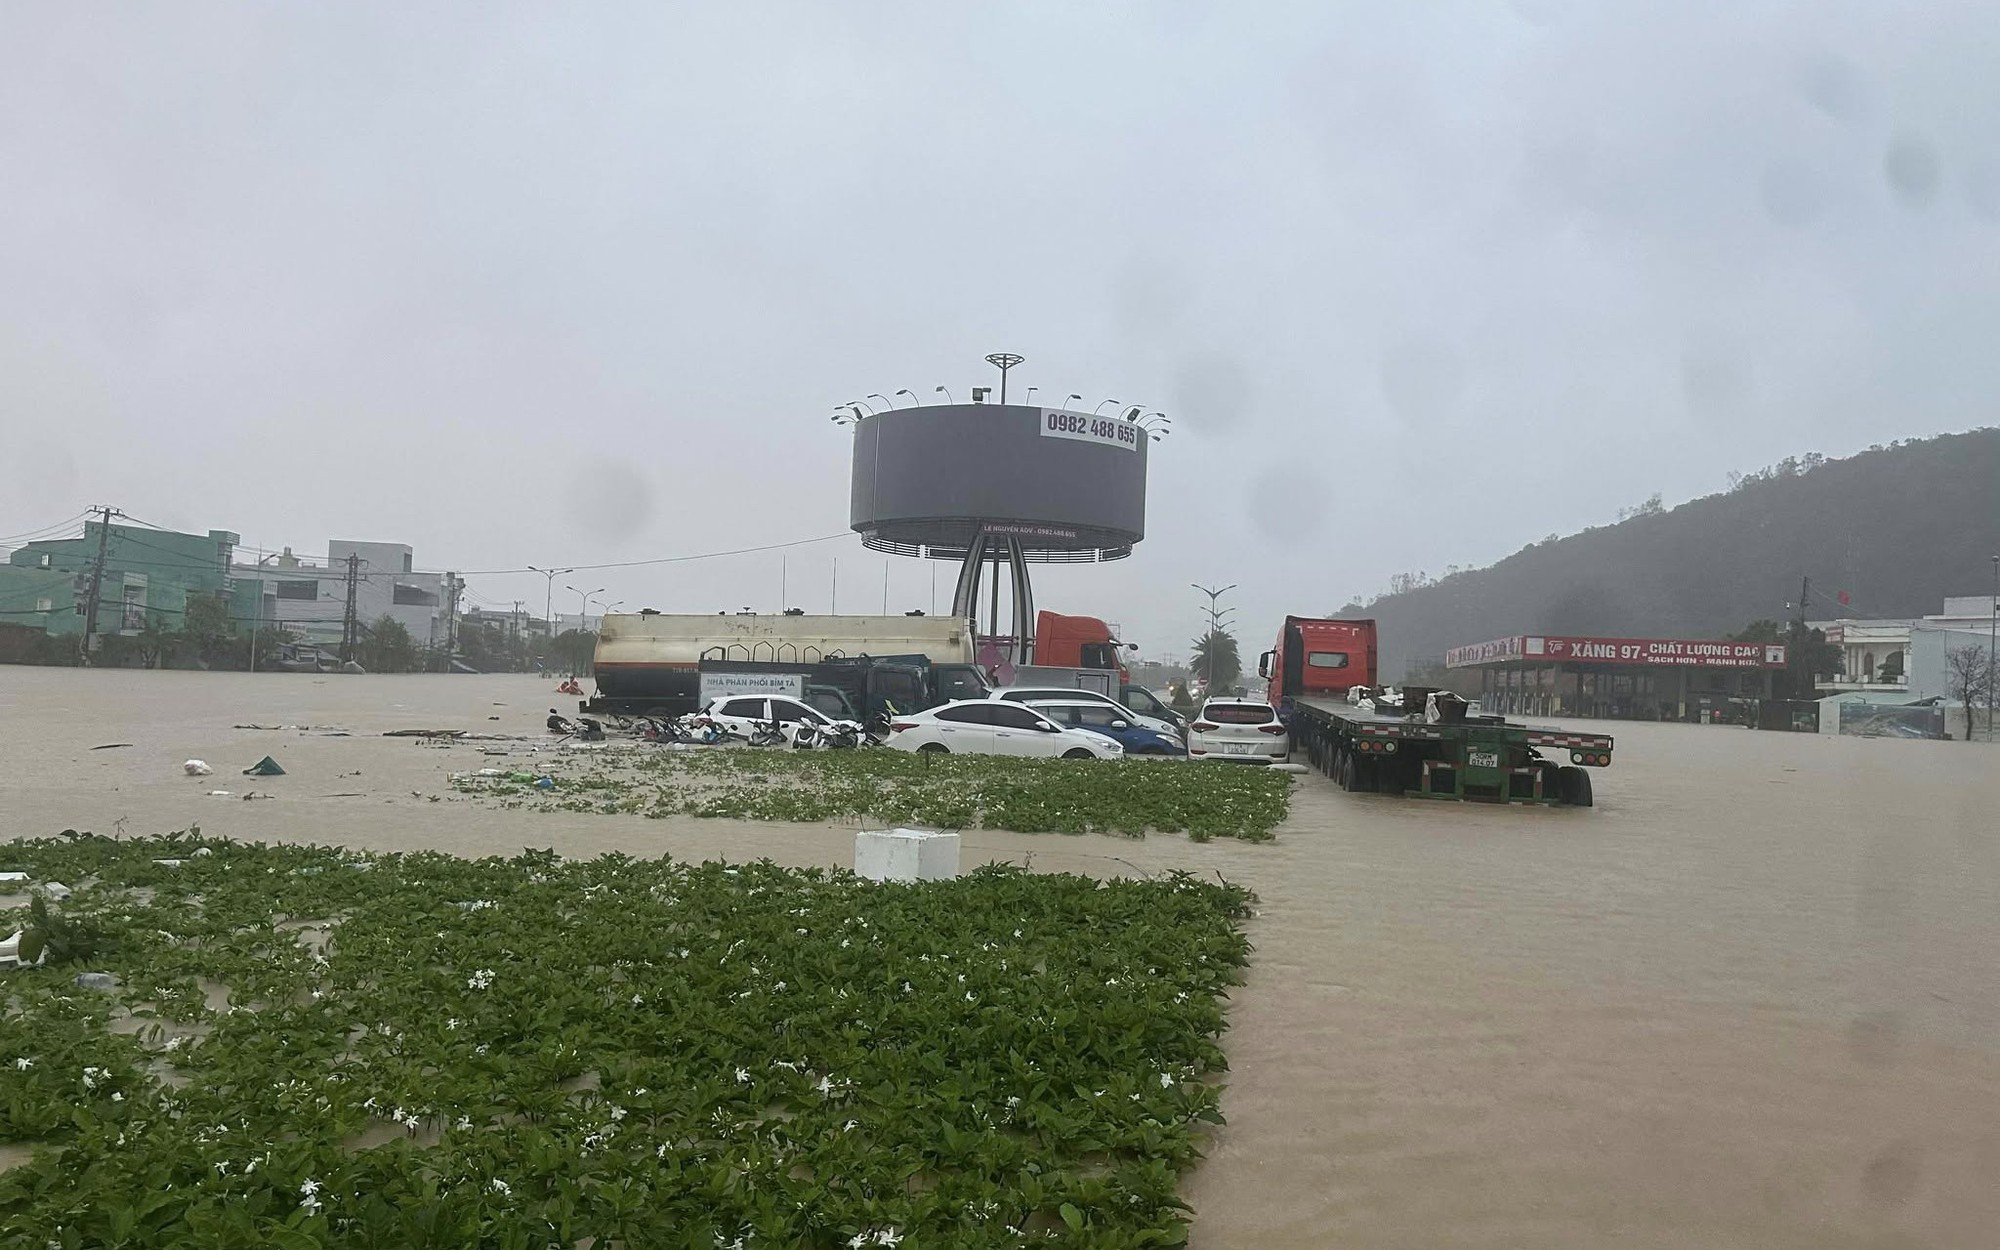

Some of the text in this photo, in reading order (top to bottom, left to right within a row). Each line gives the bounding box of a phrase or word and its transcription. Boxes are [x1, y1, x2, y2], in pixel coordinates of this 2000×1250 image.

[1047, 413, 1135, 444] 0982 488 655
[1570, 640, 1616, 659] XĂNG
[1649, 641, 1683, 655] CHẤT
[1687, 643, 1730, 657] LƯỢNG
[1648, 656, 1673, 665] SẠCH
[1676, 657, 1697, 665] HƠN
